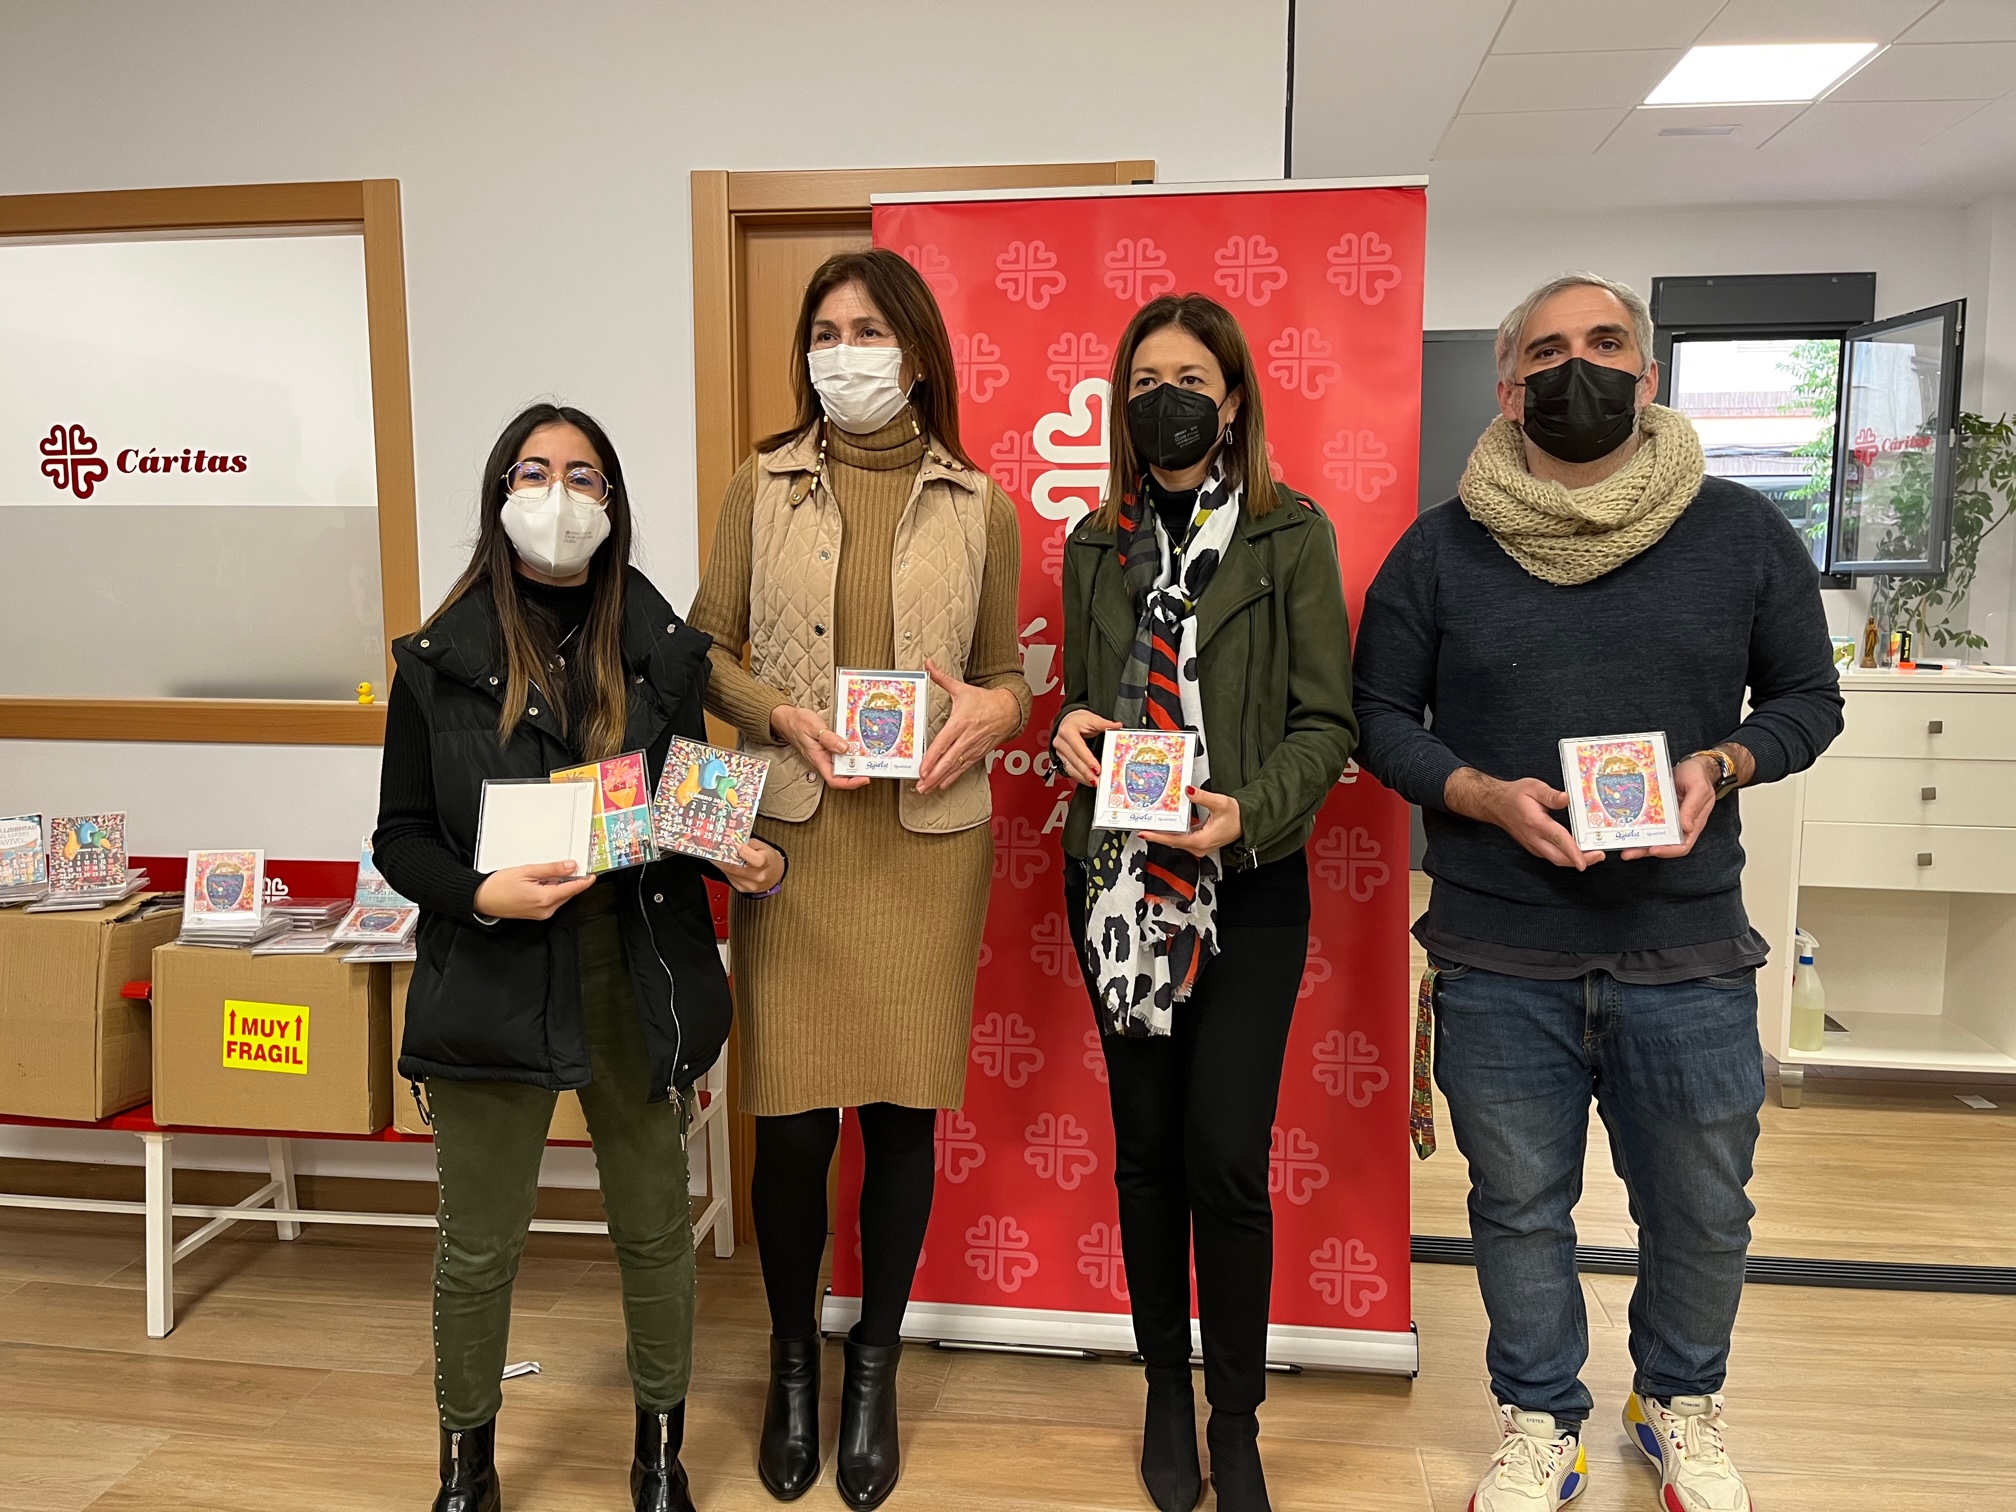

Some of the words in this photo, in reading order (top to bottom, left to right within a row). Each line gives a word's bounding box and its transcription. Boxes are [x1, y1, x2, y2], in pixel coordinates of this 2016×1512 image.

[116, 447, 248, 474] Cáritas
[242, 1016, 290, 1038] MUY
[226, 1040, 304, 1065] FRAGIL
